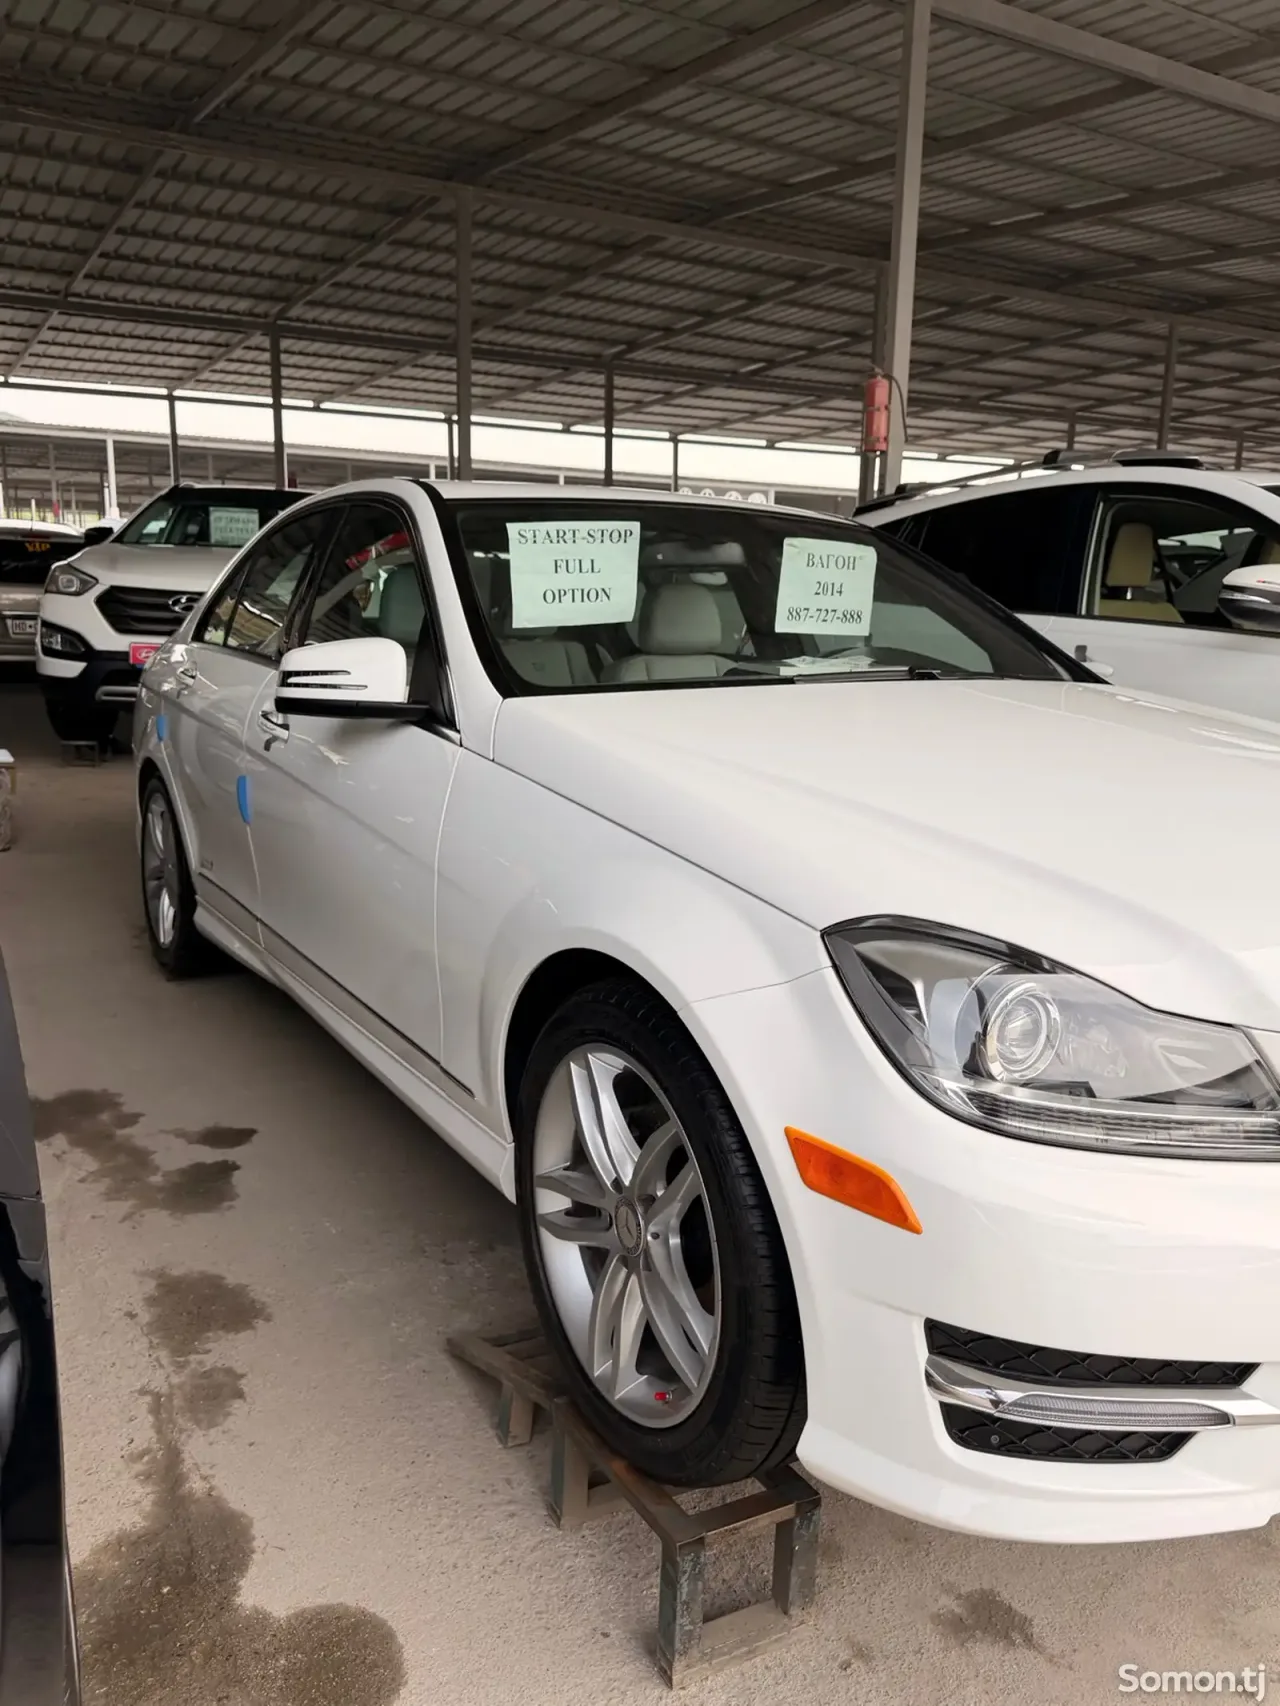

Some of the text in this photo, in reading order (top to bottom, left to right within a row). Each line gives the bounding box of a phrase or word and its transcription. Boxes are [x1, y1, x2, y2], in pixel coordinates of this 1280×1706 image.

[518, 528, 633, 544] START-STOP
[553, 558, 601, 574] FULL
[805, 552, 857, 571] ВАГОН
[542, 587, 612, 604] OPTION
[814, 580, 844, 597] 2014
[786, 606, 863, 624] 887-727-888
